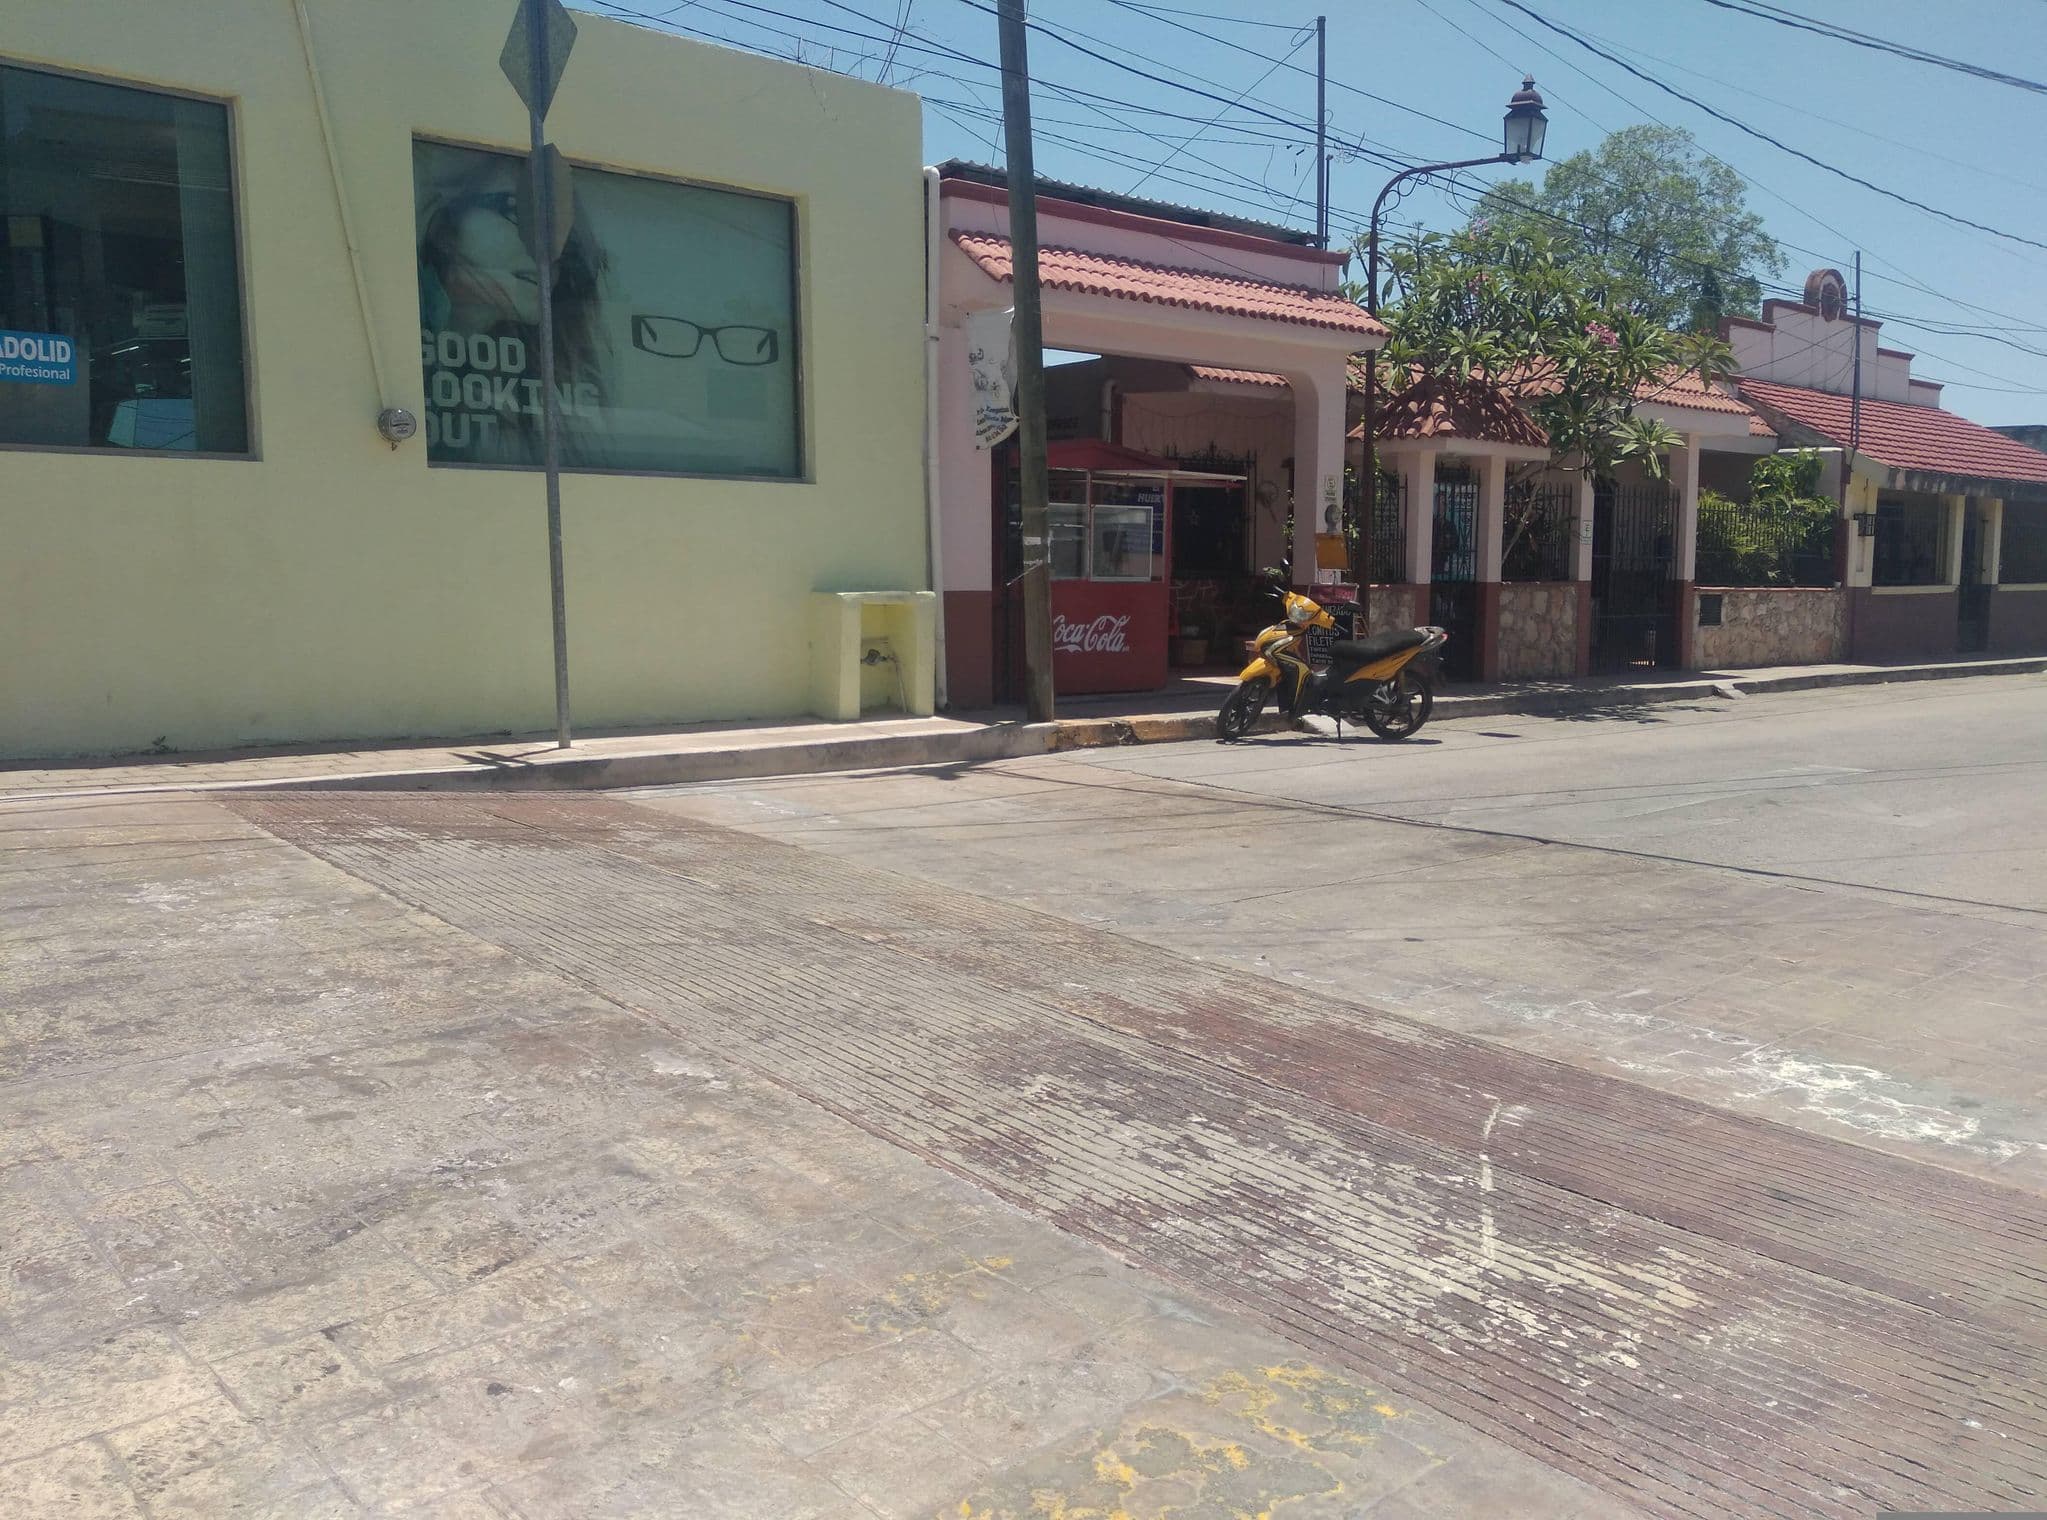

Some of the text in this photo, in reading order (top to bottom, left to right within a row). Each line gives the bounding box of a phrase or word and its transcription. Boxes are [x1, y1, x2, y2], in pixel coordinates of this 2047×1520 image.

[0, 337, 70, 362] DOLID
[0, 364, 69, 379] Profesional
[424, 371, 600, 417] OOKING
